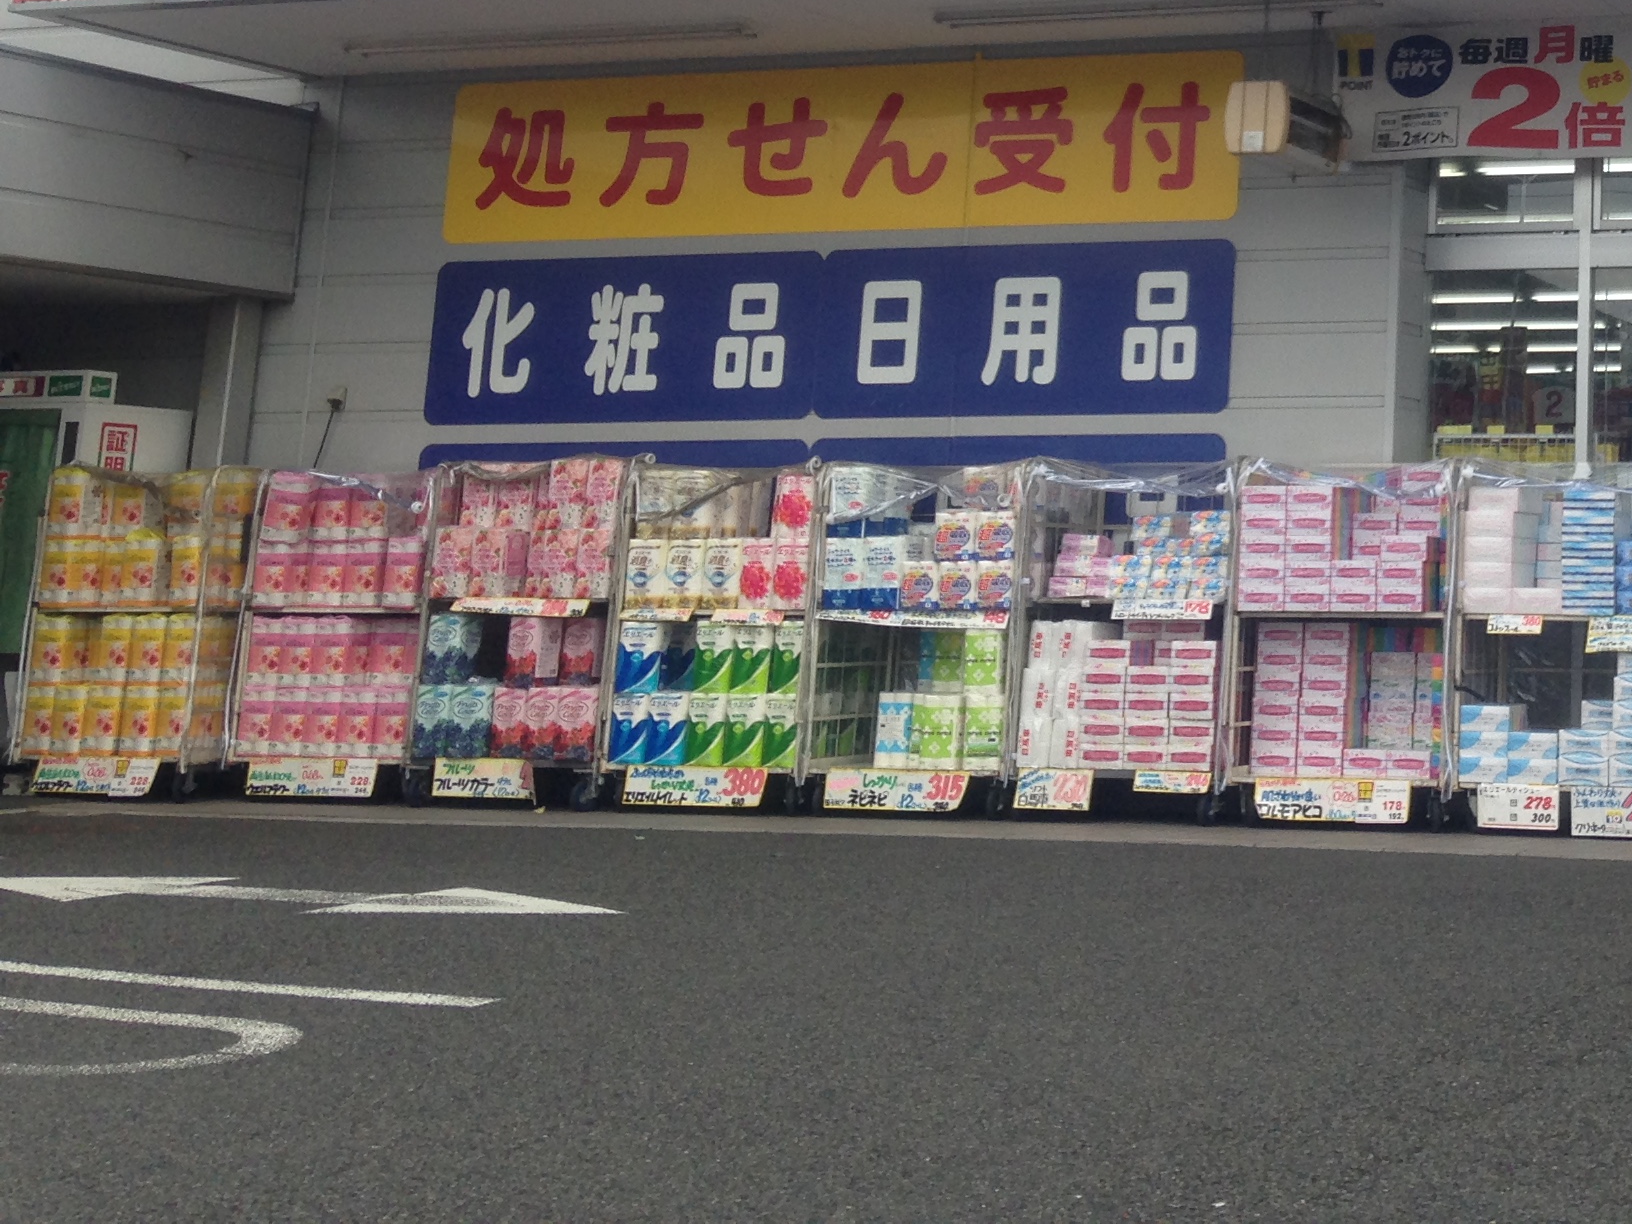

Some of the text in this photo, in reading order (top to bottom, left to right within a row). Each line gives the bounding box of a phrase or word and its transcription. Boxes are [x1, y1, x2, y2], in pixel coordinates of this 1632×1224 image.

[1458, 24, 1614, 65] 毎週月曜
[1391, 58, 1443, 80] 貯めて
[1466, 66, 1626, 150] 2倍
[474, 80, 1212, 210] 処方せん受付
[462, 282, 787, 398] 化粧品
[856, 270, 1198, 385] 日用品
[1545, 390, 1563, 418] 2
[350, 776, 370, 786] 228
[721, 767, 766, 797] 380
[924, 772, 966, 801] 315
[1382, 801, 1402, 811] 178
[1523, 796, 1552, 810] 278
[1531, 813, 1552, 824] 300
